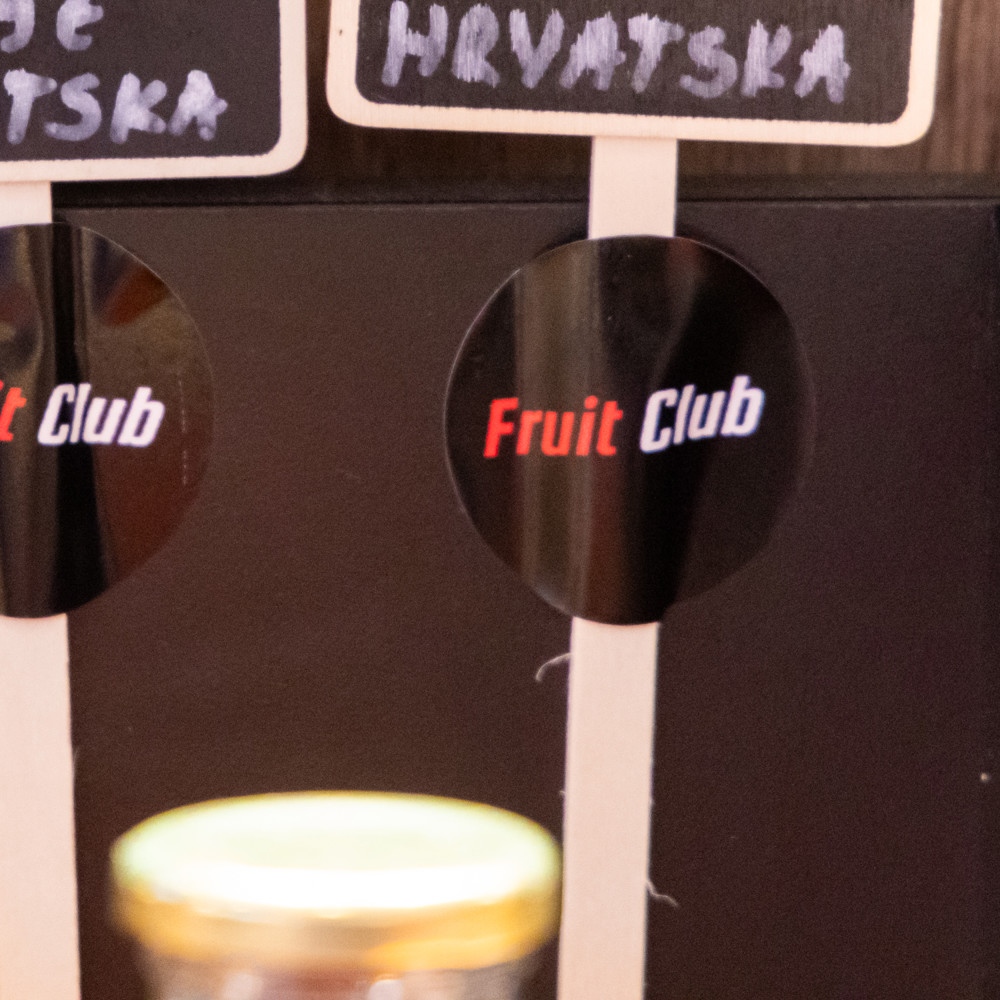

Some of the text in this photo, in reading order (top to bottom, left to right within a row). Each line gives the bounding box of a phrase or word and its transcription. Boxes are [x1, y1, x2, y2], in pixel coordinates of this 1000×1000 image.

[381, 0, 851, 103] HRVATSKA
[36, 382, 166, 447] Club
[483, 374, 766, 458] Fruit Club
